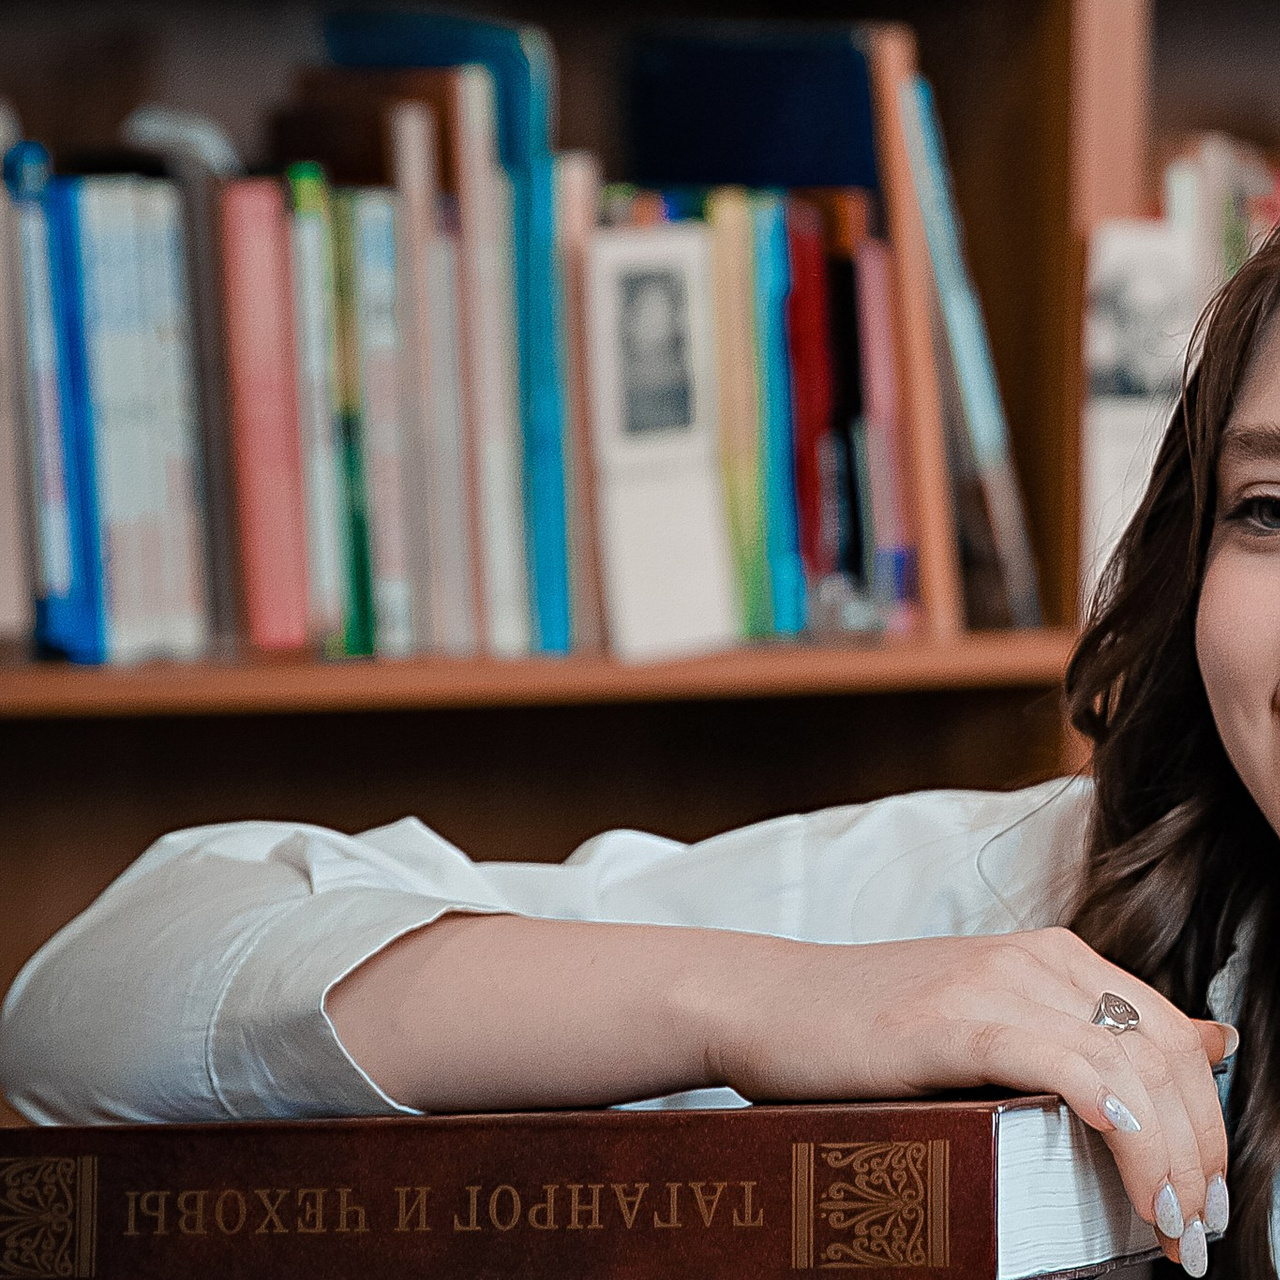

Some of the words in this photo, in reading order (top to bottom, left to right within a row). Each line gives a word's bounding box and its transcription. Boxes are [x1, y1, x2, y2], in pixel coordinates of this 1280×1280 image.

[127, 1187, 371, 1235] ЧЕХОВЫ
[393, 1185, 432, 1233] И
[453, 1180, 765, 1231] ТАГАНРОГ
